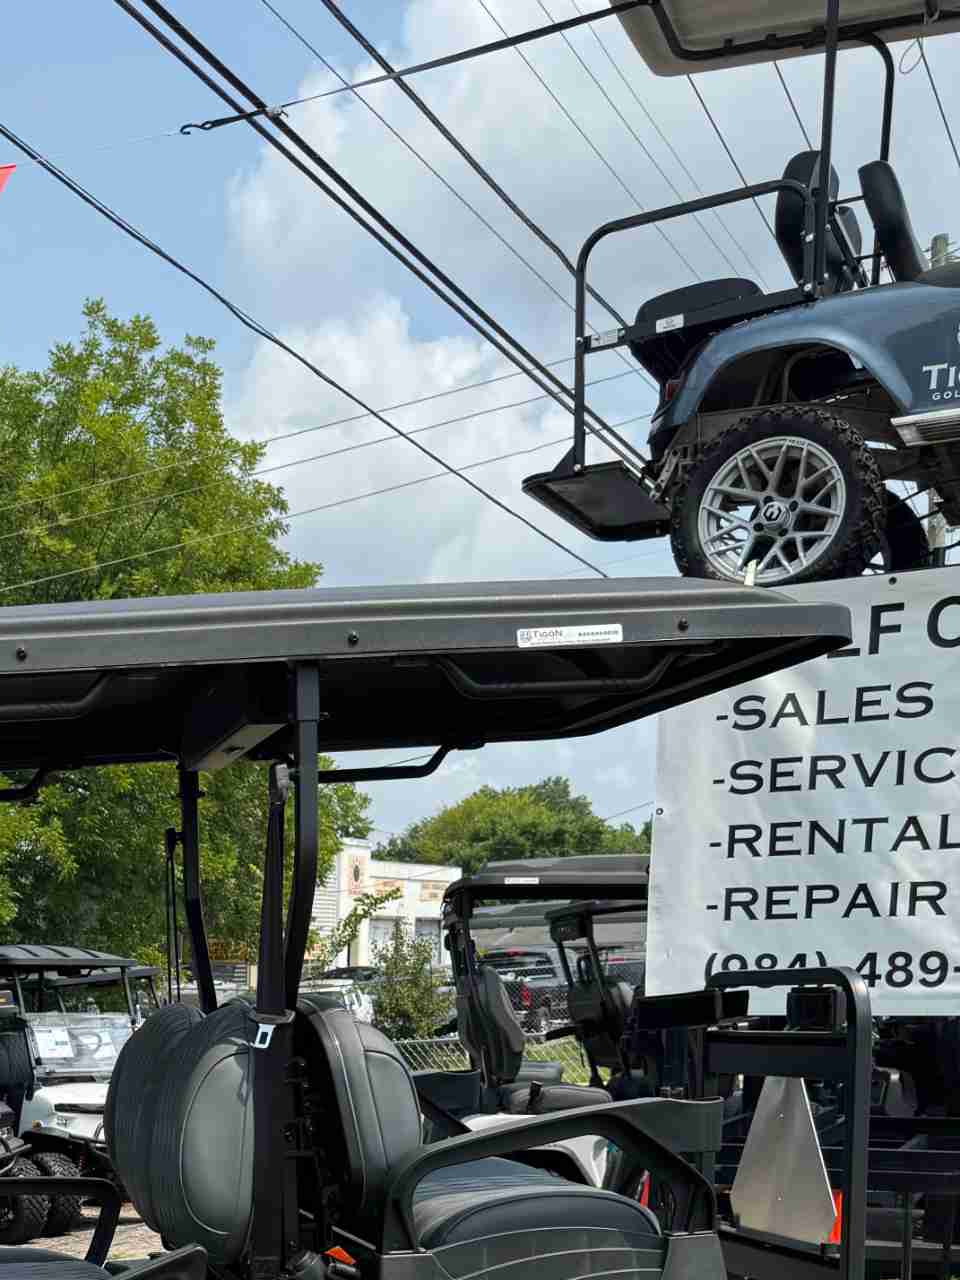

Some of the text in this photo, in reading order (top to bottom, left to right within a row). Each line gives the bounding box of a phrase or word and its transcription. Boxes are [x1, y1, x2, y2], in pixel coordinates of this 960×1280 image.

[922, 363, 960, 389] TI
[716, 682, 933, 731] -SALES
[712, 747, 957, 795] -SERVIC
[709, 814, 960, 859] -RENTAL
[706, 880, 948, 921] -REPAIR
